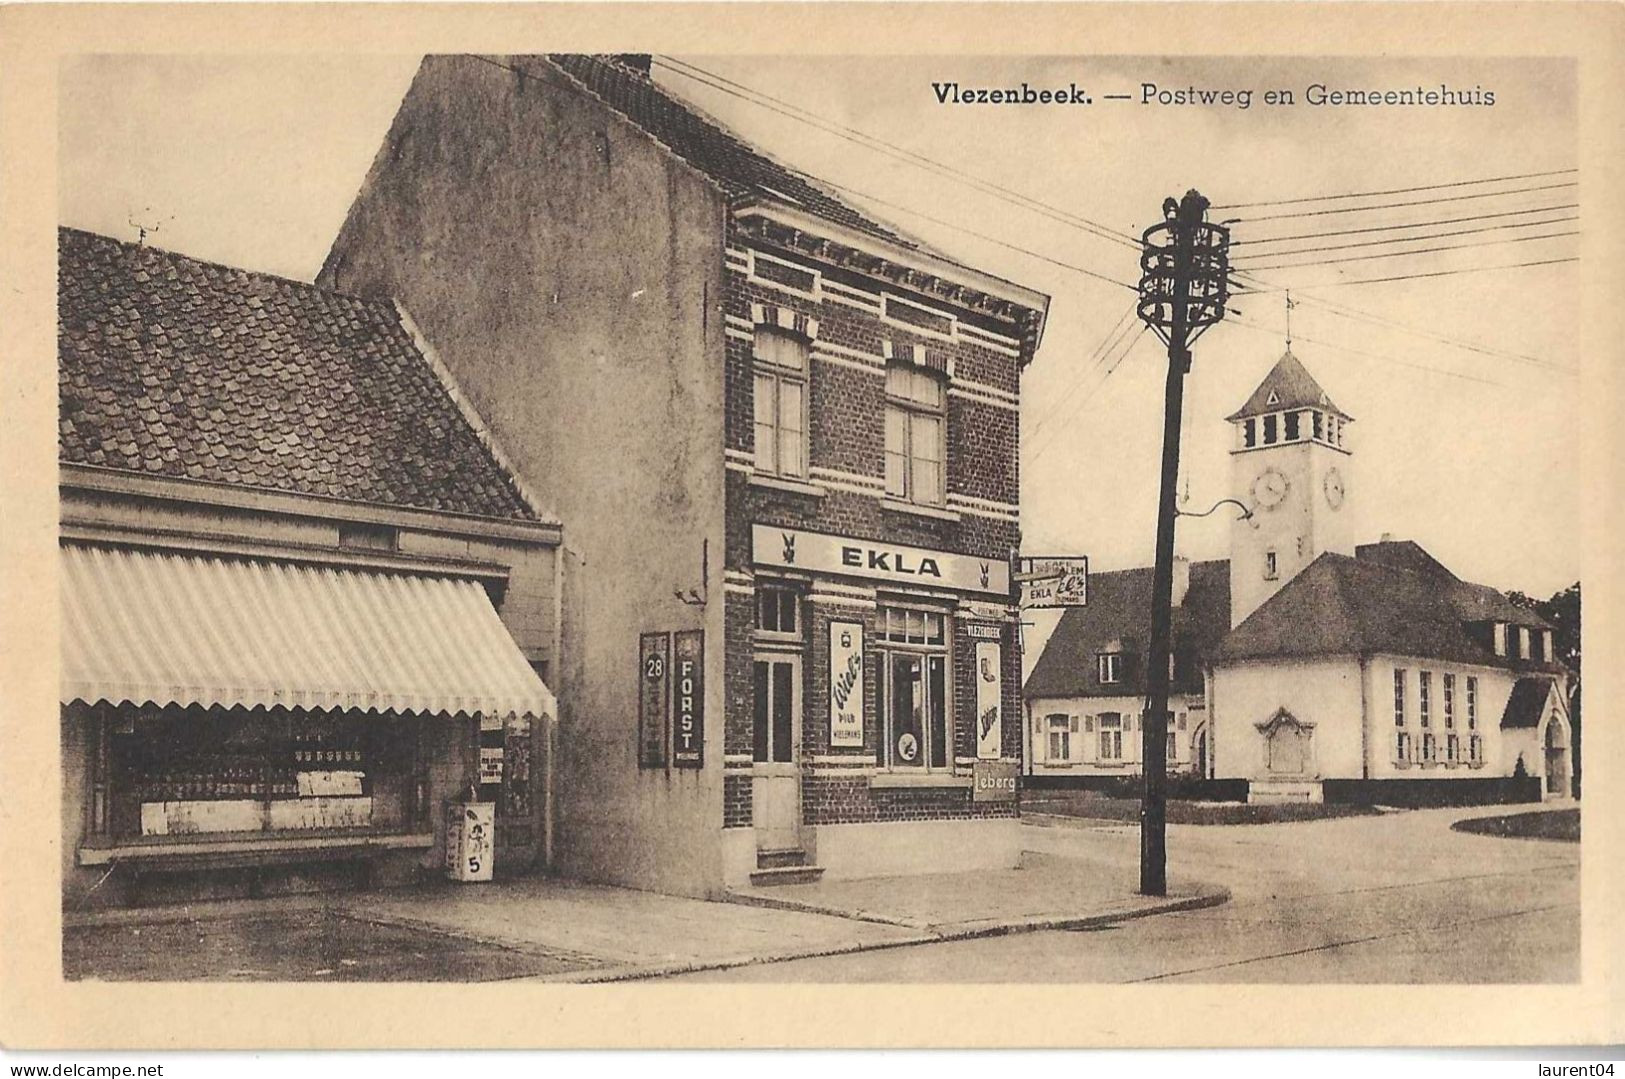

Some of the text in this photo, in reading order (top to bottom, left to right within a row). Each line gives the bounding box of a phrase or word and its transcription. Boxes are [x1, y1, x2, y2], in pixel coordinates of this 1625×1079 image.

[842, 546, 941, 577] EKLA
[647, 659, 662, 677] 28
[833, 652, 861, 710] Wiel's
[681, 661, 693, 748] FORST
[975, 772, 1016, 793] Leberg
[468, 856, 480, 873] 5
